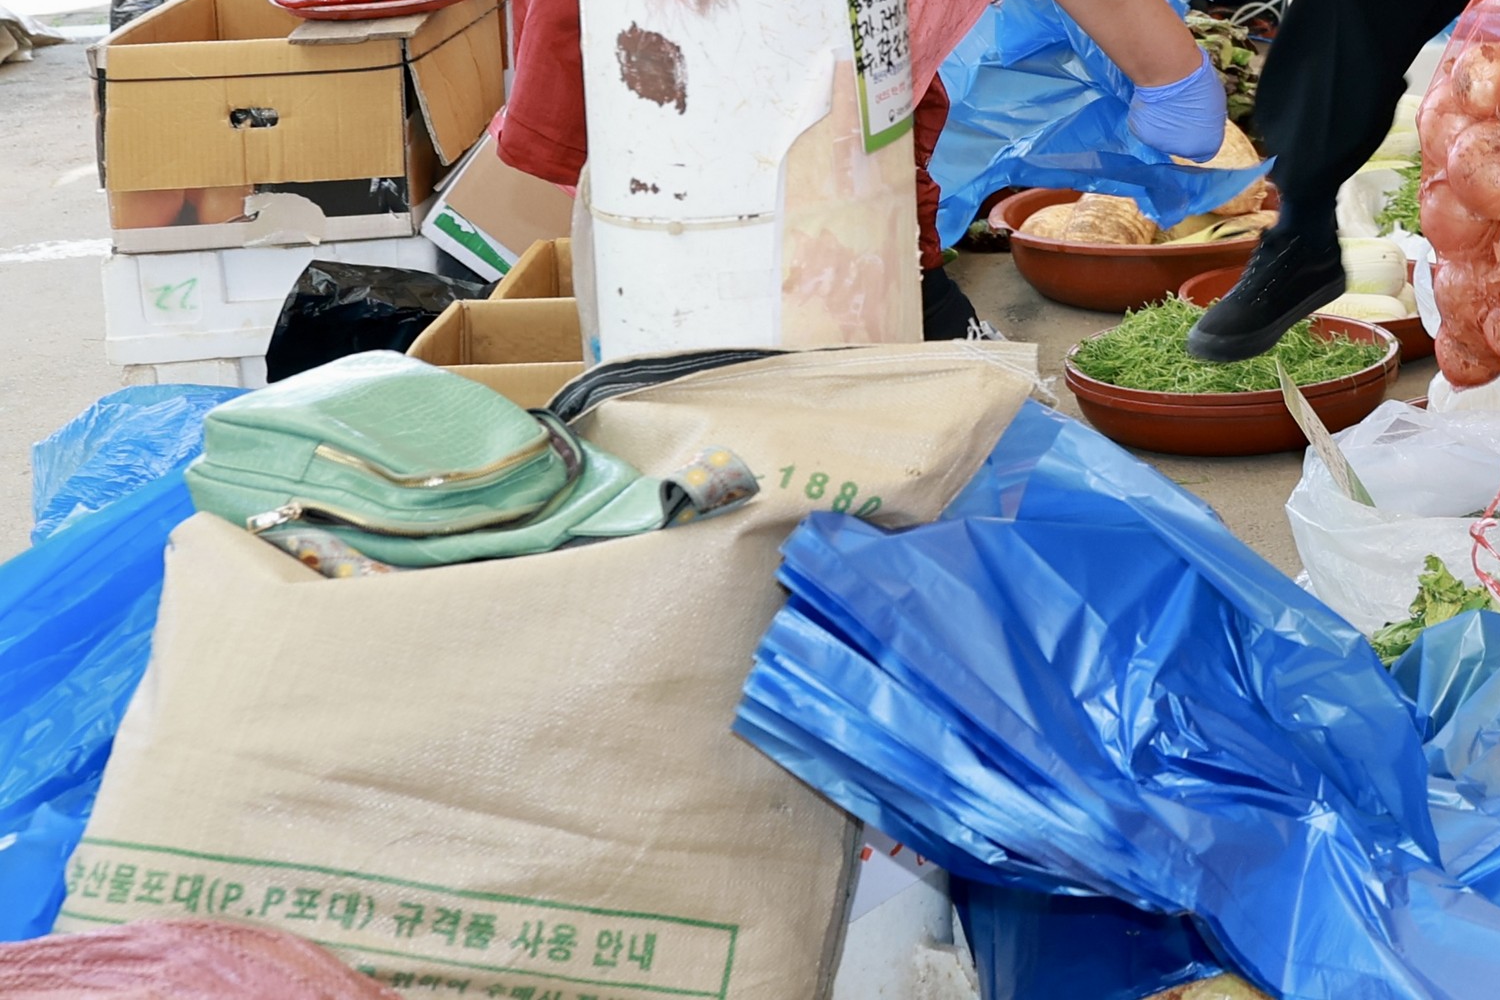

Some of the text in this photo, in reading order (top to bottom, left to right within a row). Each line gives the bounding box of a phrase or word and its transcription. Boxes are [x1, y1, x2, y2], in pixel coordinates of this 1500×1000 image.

[392, 901, 498, 950] 규격품
[510, 919, 578, 963] 사용
[592, 928, 658, 972] 안내
